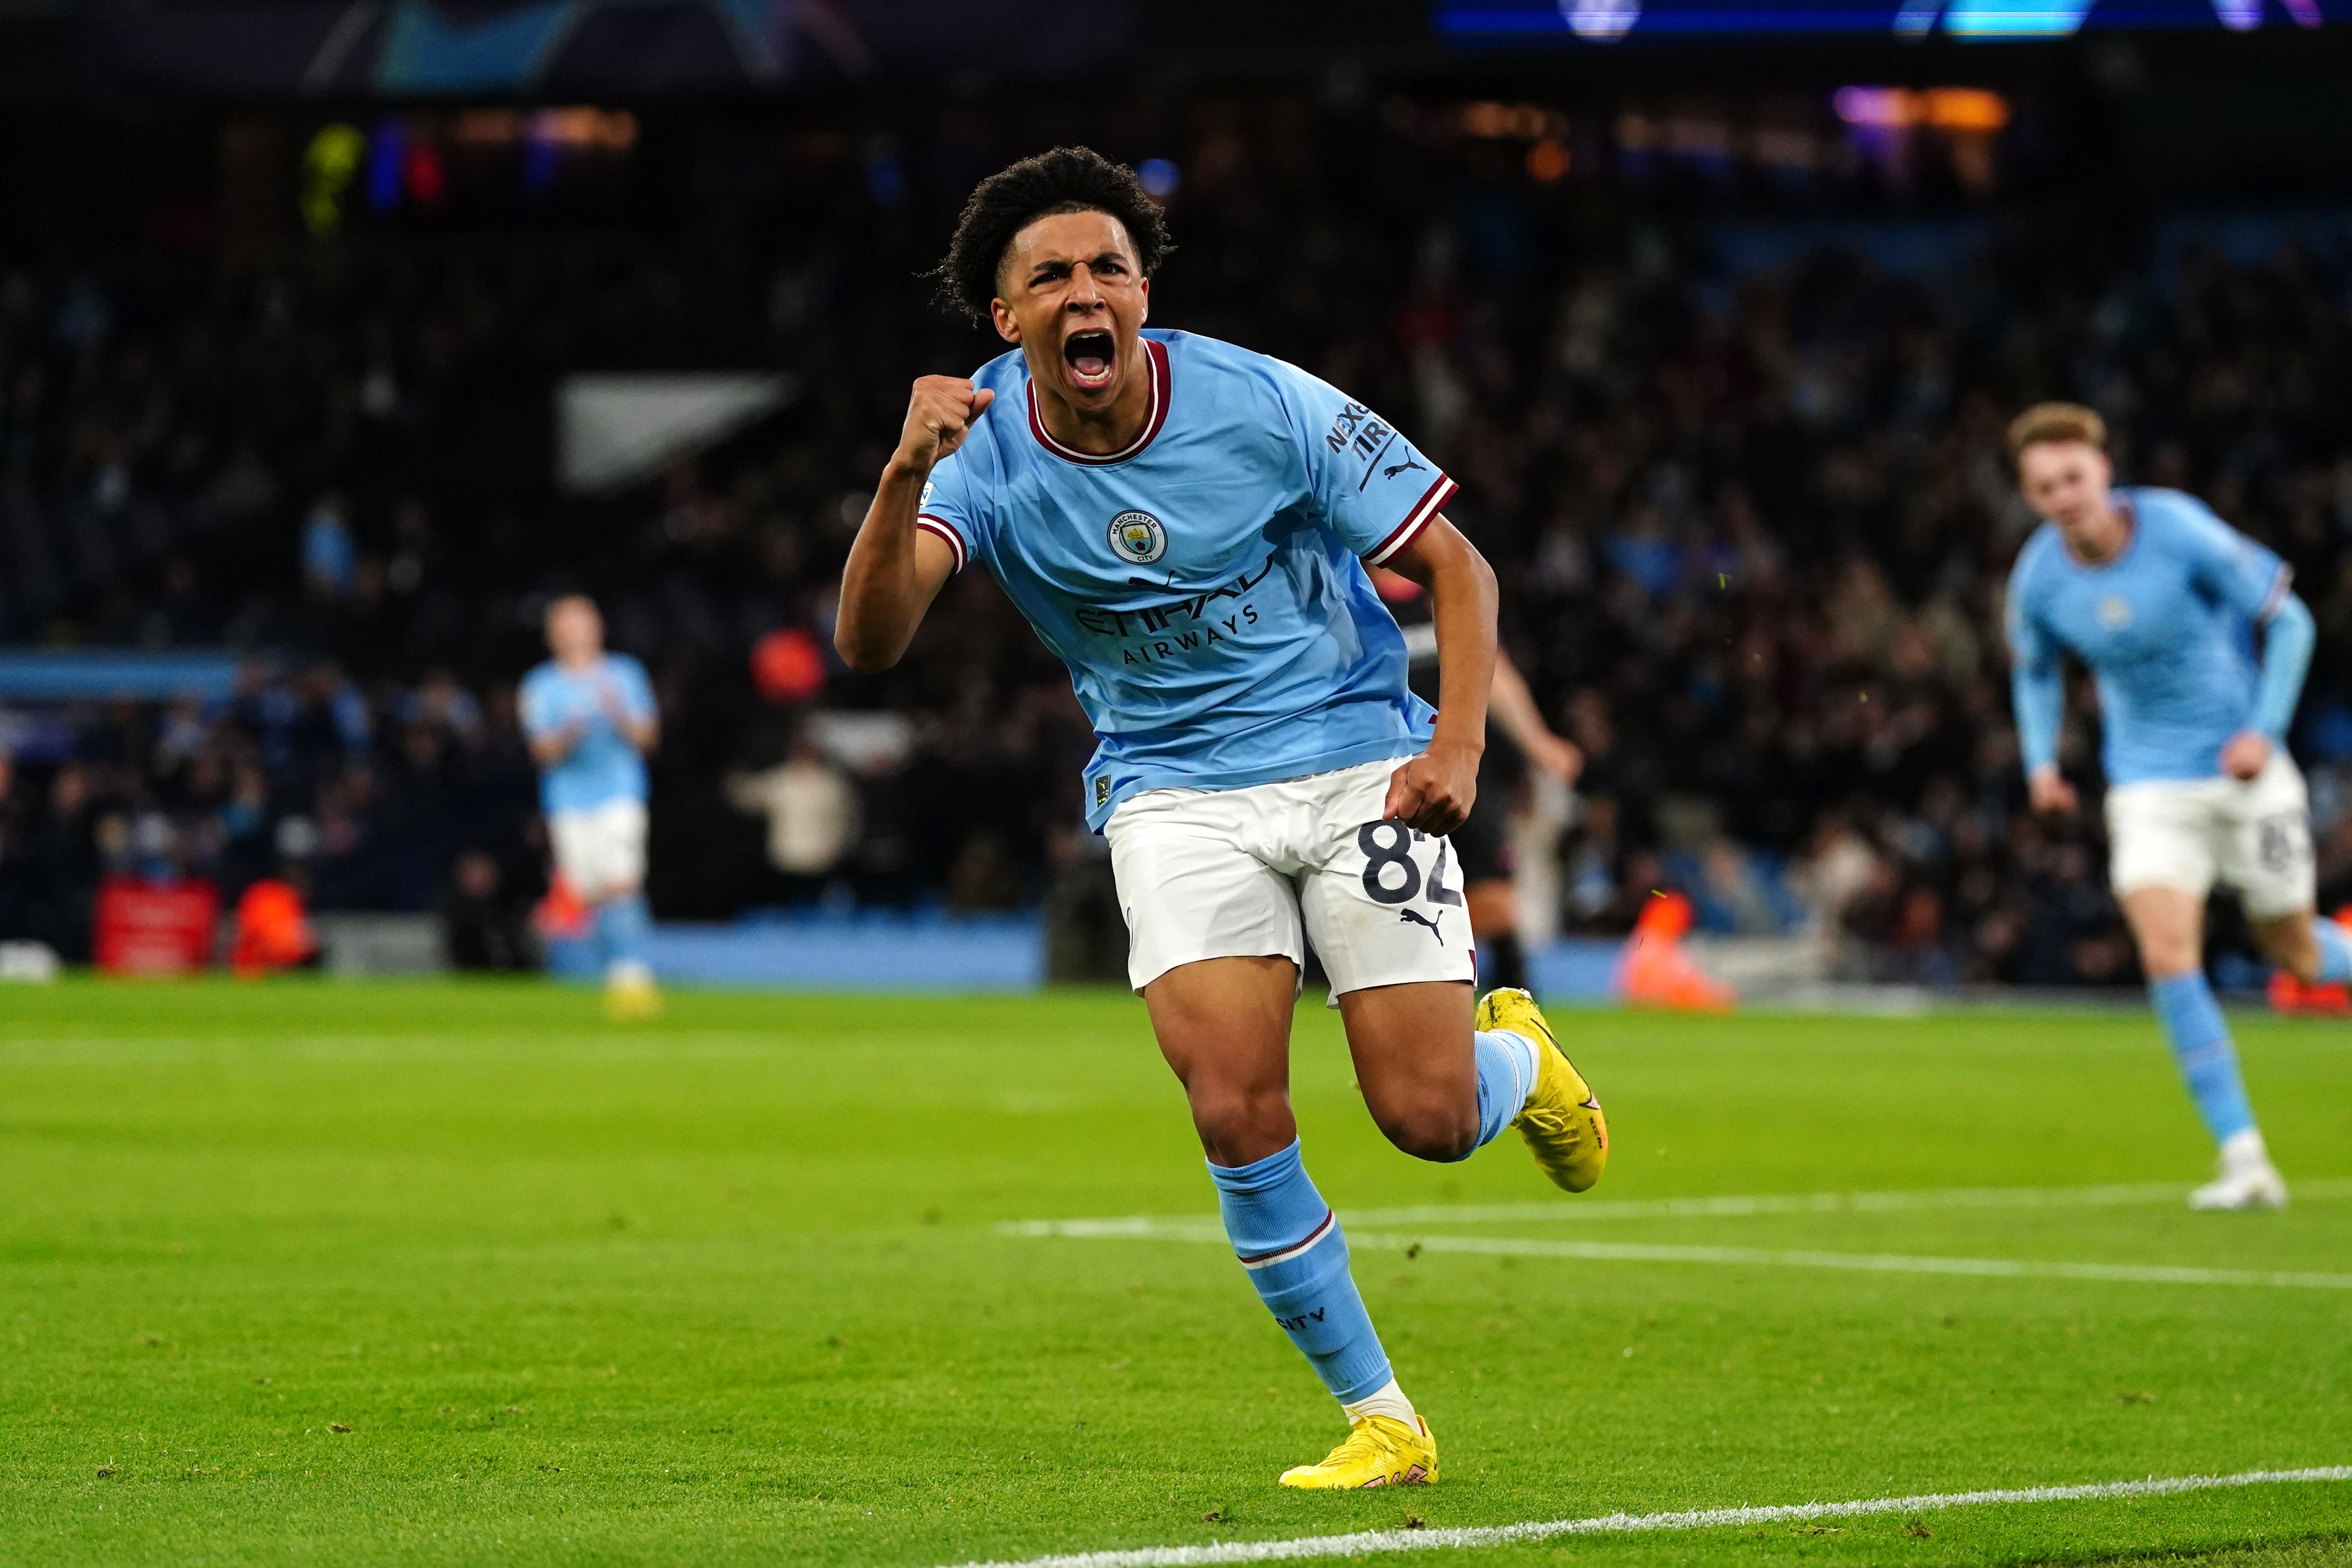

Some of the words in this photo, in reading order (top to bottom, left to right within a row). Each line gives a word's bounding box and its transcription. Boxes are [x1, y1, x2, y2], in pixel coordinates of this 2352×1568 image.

[1112, 514, 1157, 535] MANCHESTER
[1074, 553, 1273, 637] ETIHAD
[1122, 603, 1258, 665] AIRWAYS
[1357, 818, 1462, 908] 82
